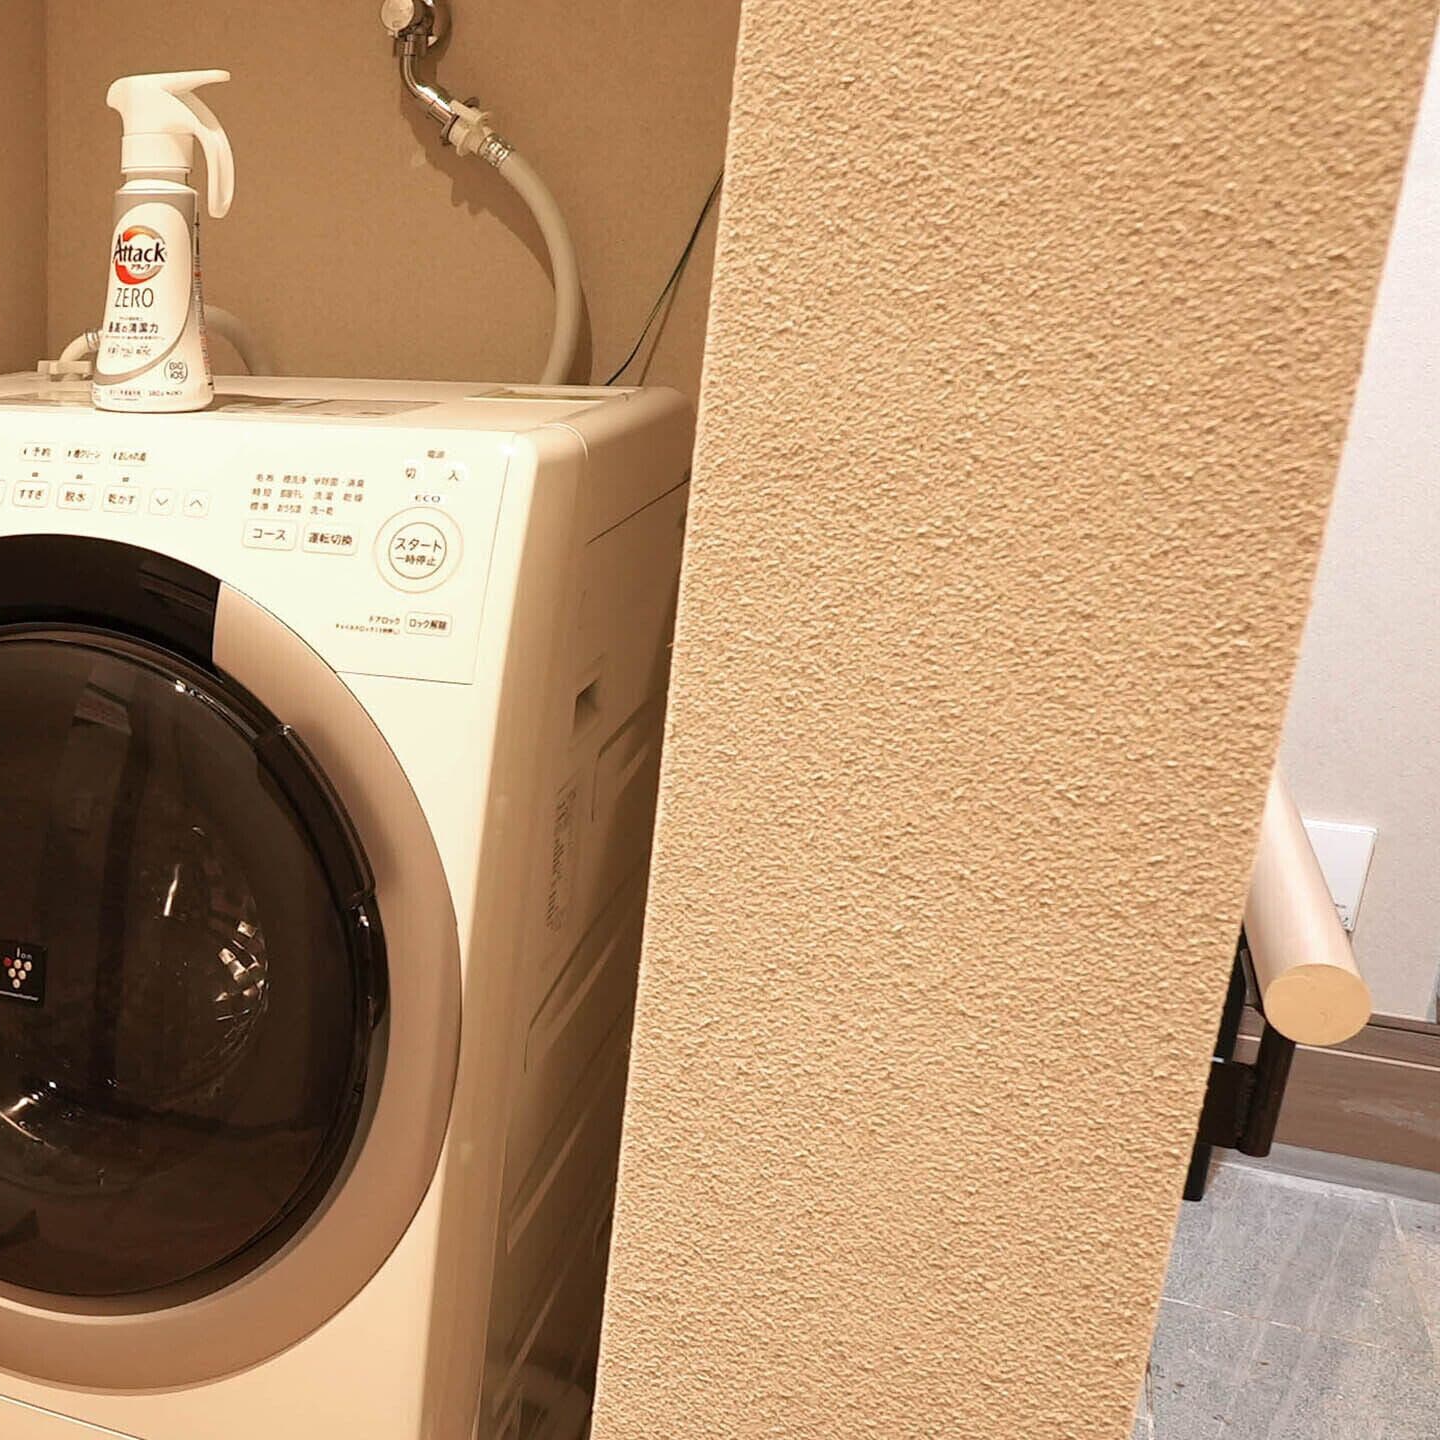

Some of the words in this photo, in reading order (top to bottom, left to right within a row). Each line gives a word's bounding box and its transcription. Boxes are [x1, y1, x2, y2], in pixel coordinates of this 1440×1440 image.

[113, 234, 166, 263] Attack
[115, 288, 154, 308] ZERO
[406, 468, 416, 479] 切
[448, 470, 459, 481] 入
[20, 489, 42, 499] すすぎ
[66, 491, 85, 502] 脱水
[108, 494, 134, 504] 乾かす
[253, 528, 285, 540] コース
[309, 533, 352, 545] 運転切換
[395, 537, 442, 552] スタート
[395, 555, 436, 567] 一時停止
[410, 619, 447, 630] ロック解除
